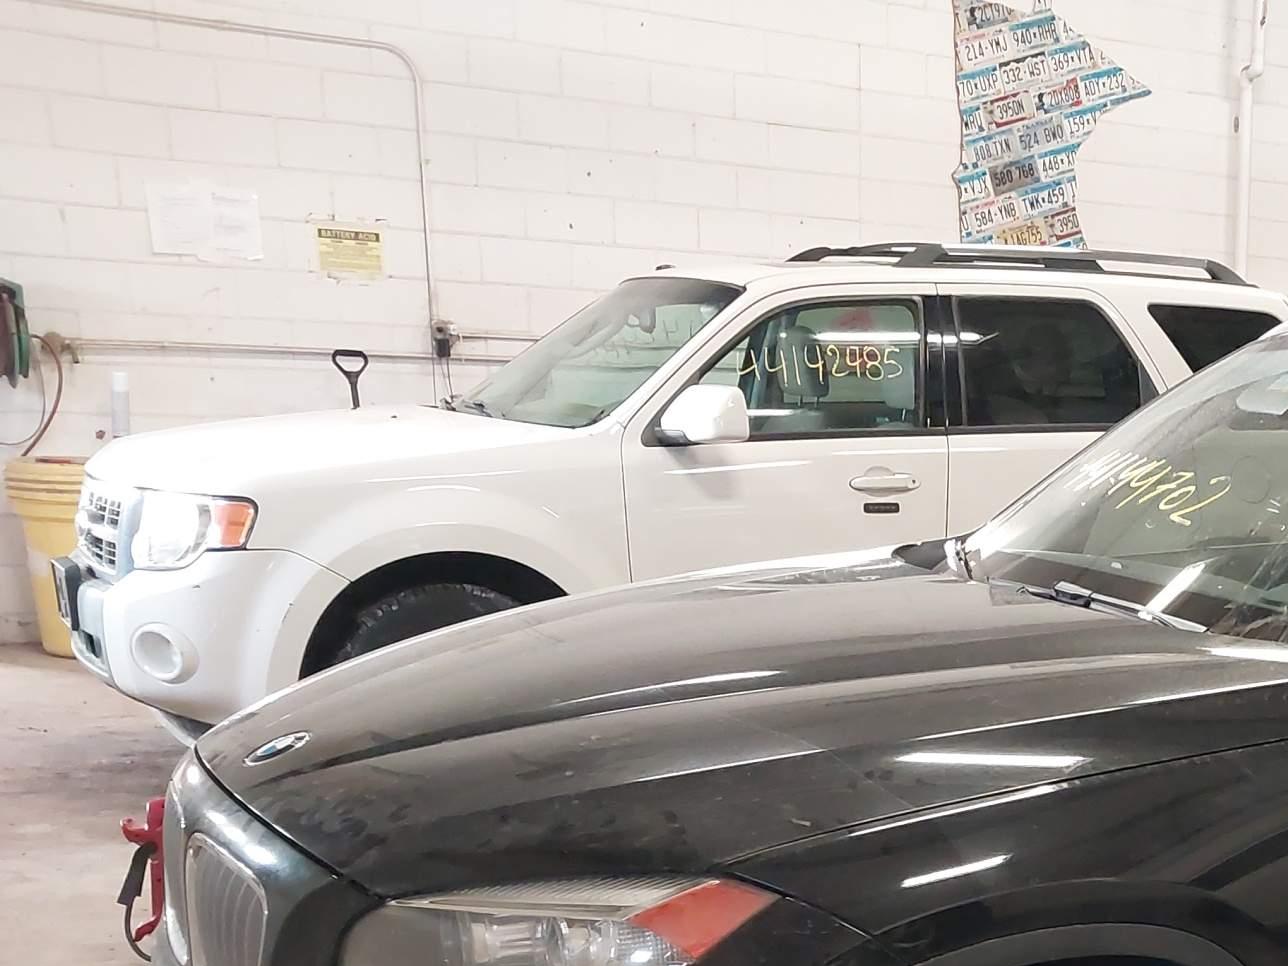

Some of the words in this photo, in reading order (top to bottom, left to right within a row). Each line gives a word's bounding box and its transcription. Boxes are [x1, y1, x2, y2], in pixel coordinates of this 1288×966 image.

[1051, 53, 1069, 72] 369
[1107, 73, 1125, 91] 232
[320, 229, 355, 240] BATTERY
[358, 231, 377, 242] ACID
[736, 343, 903, 388] 44142485
